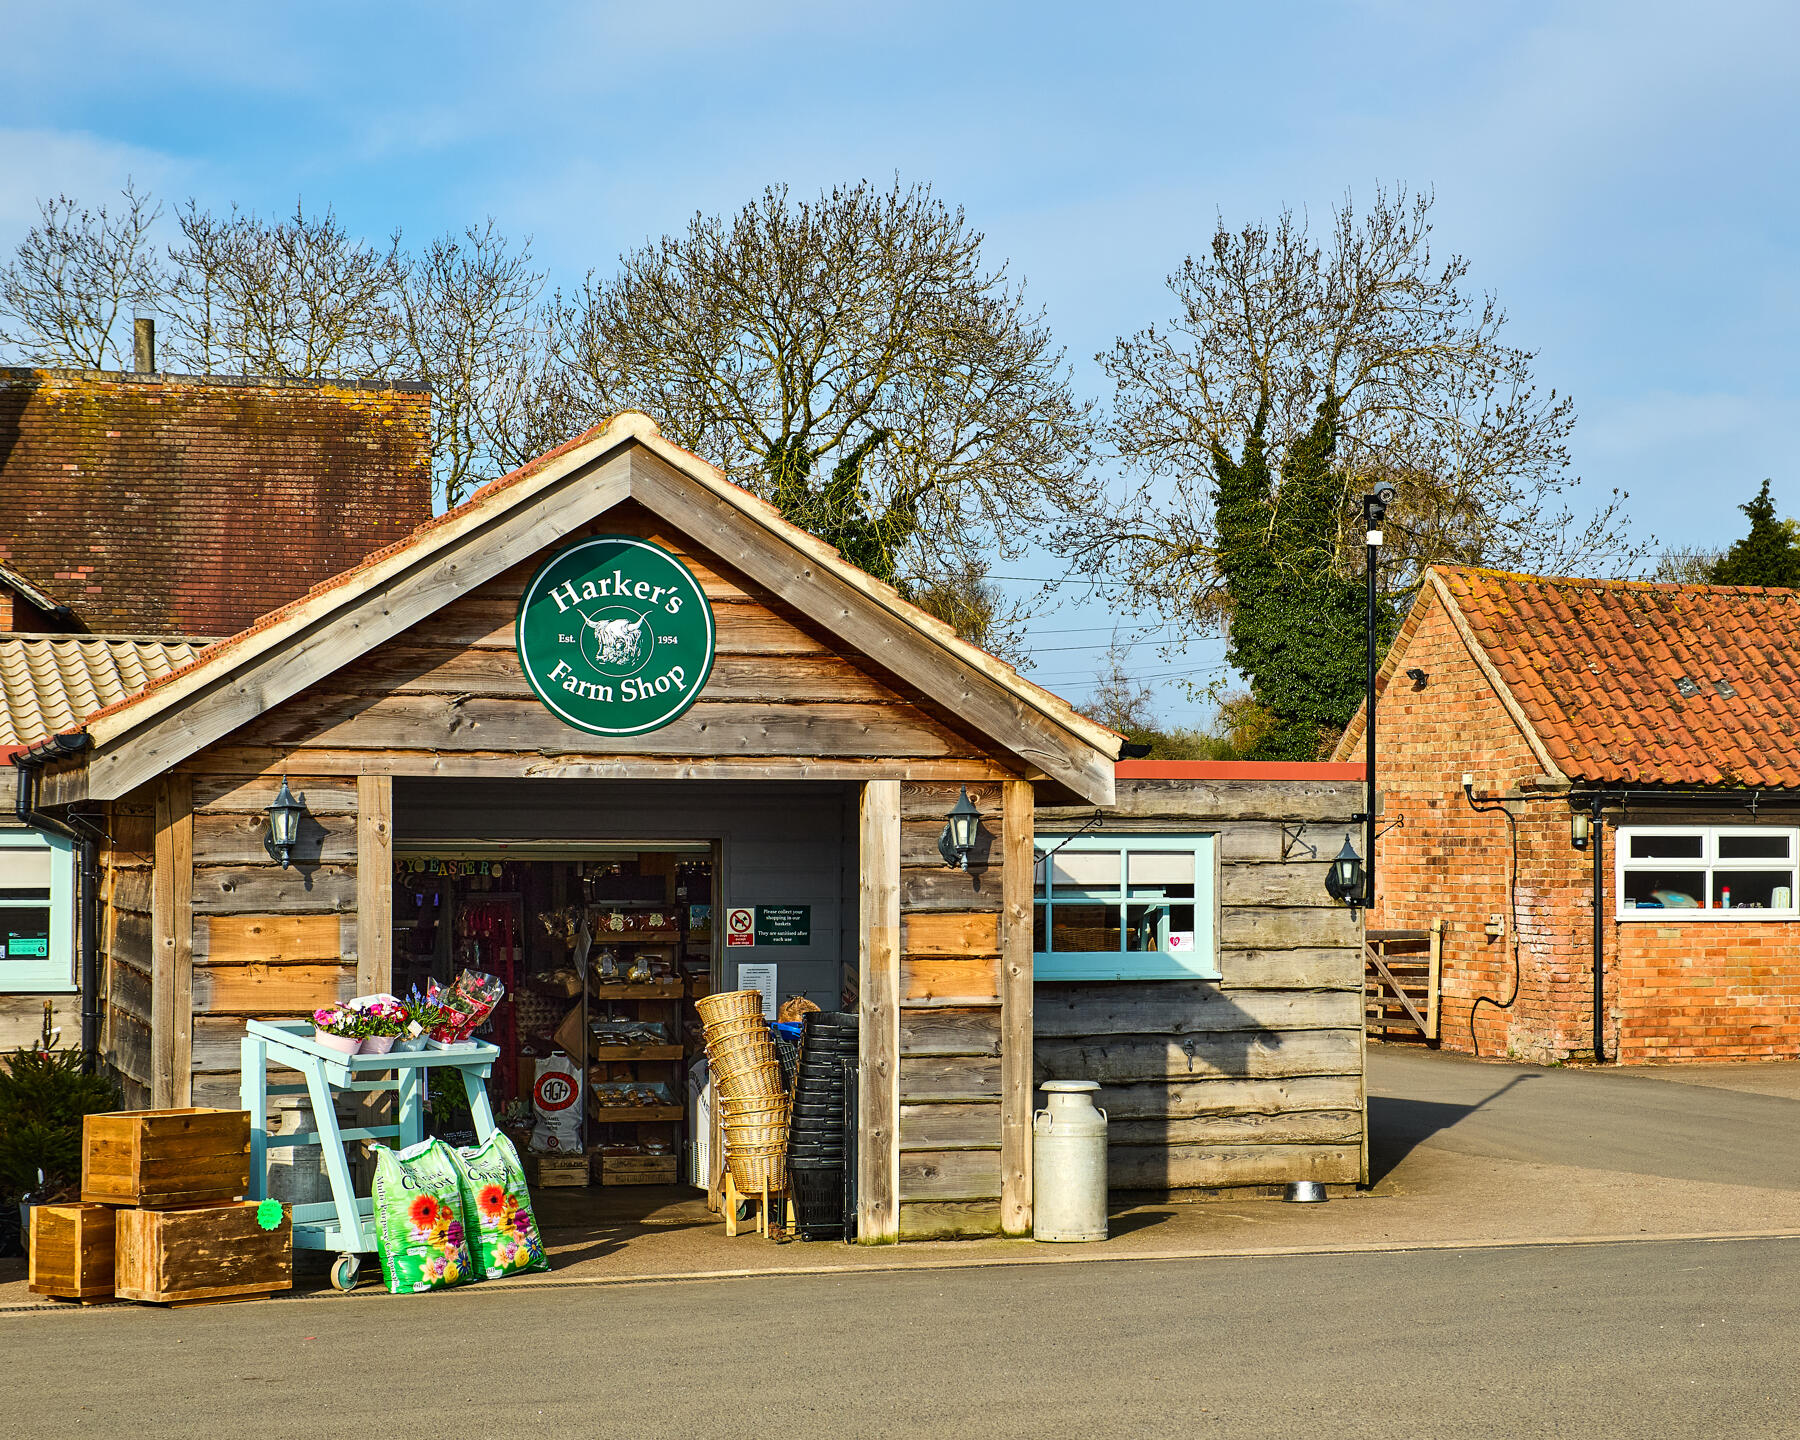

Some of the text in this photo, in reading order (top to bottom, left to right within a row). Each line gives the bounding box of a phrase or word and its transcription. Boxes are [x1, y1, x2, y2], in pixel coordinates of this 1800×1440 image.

[547, 569, 684, 614] Harker's
[558, 633, 678, 645] Est. 1954
[546, 658, 687, 703] Farm Shop
[428, 859, 490, 876] EASTER
[376, 1175, 386, 1201] Multi
[379, 1203, 390, 1241] Purpose
